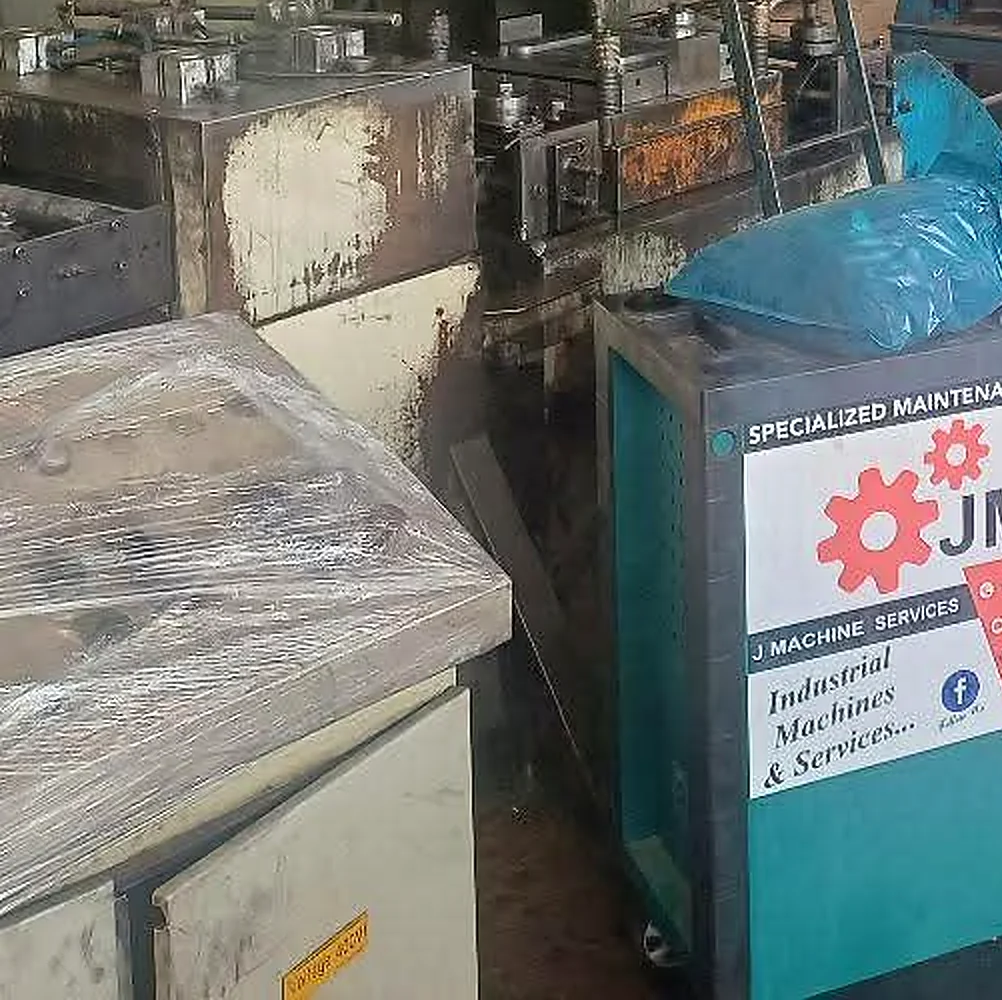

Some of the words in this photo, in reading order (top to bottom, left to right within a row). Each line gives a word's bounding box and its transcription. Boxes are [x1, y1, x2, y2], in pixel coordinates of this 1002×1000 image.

[749, 402, 887, 445] SPECIALIZED
[751, 647, 764, 662] J
[770, 621, 865, 657] MACHINE
[875, 597, 960, 631] SERVICES
[767, 645, 892, 716] Industrial
[774, 685, 897, 748] Machines
[763, 762, 786, 788] &
[792, 721, 915, 777] Services...
